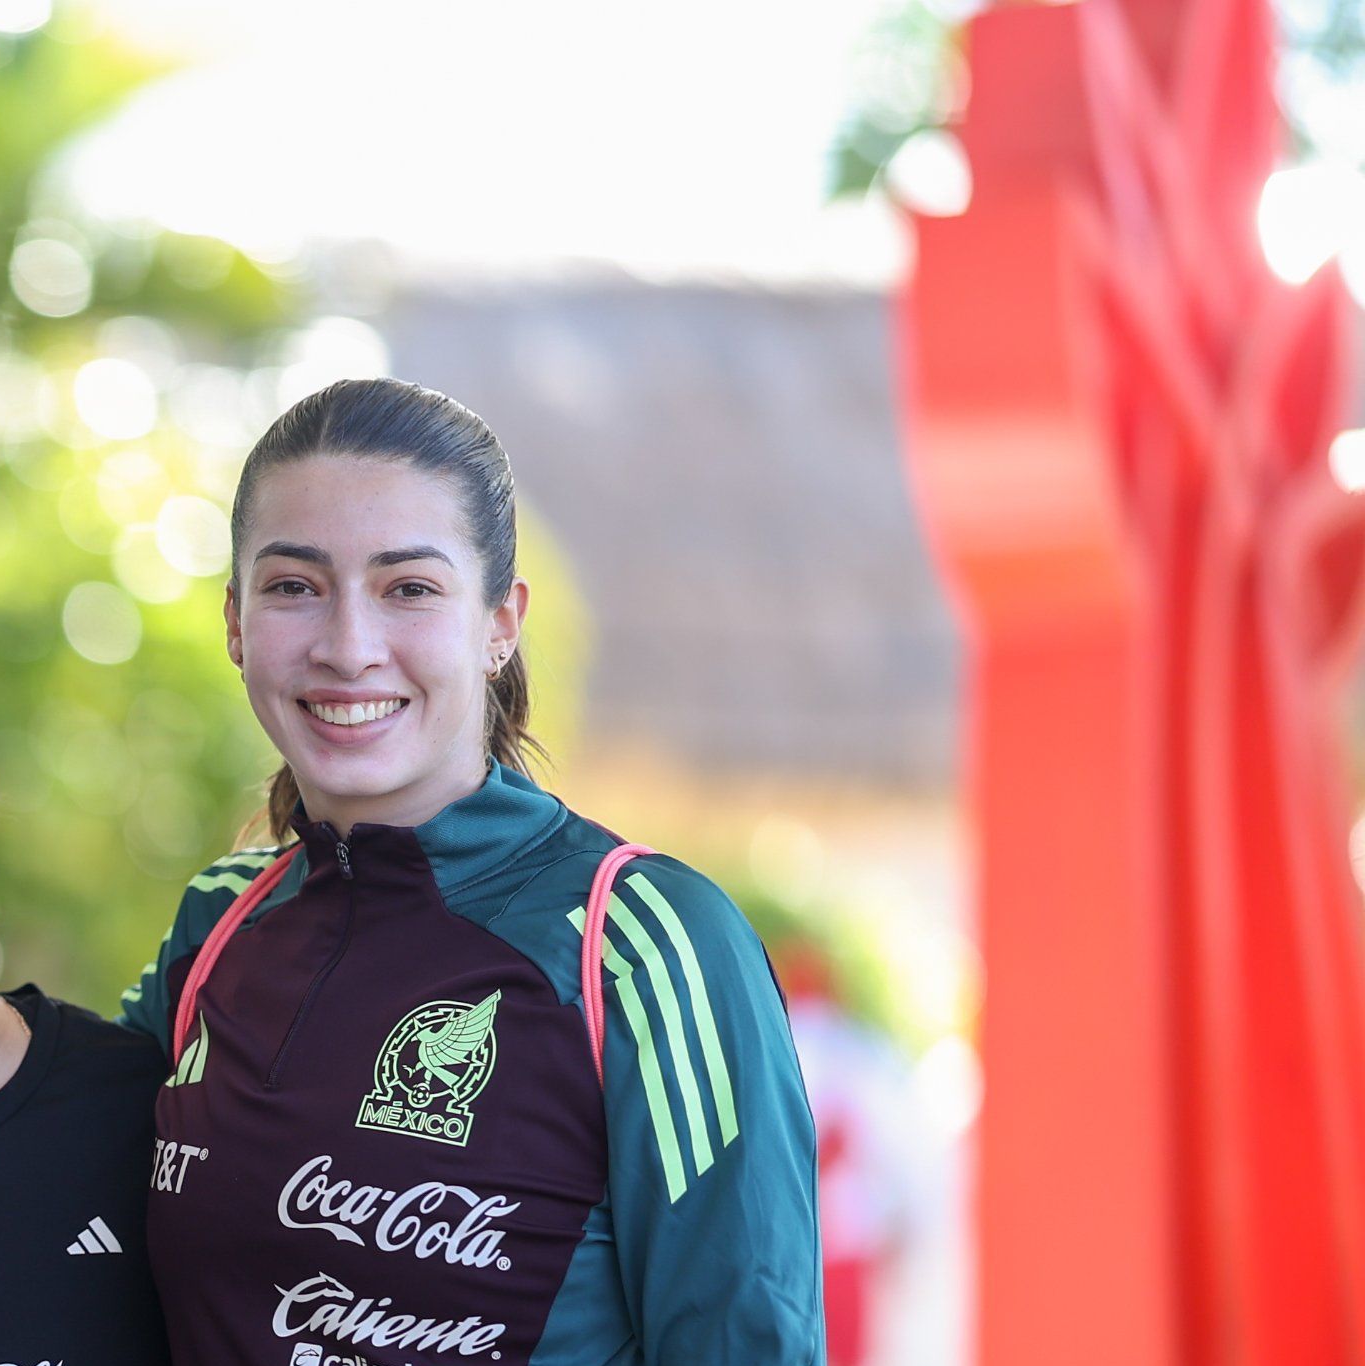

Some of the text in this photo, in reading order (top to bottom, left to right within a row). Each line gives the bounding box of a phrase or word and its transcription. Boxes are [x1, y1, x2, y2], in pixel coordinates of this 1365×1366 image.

[362, 1100, 465, 1139] MÉXICO
[150, 1137, 201, 1194] T&T
[277, 1154, 521, 1268] Coca-Cola
[272, 1270, 507, 1356] Caliente
